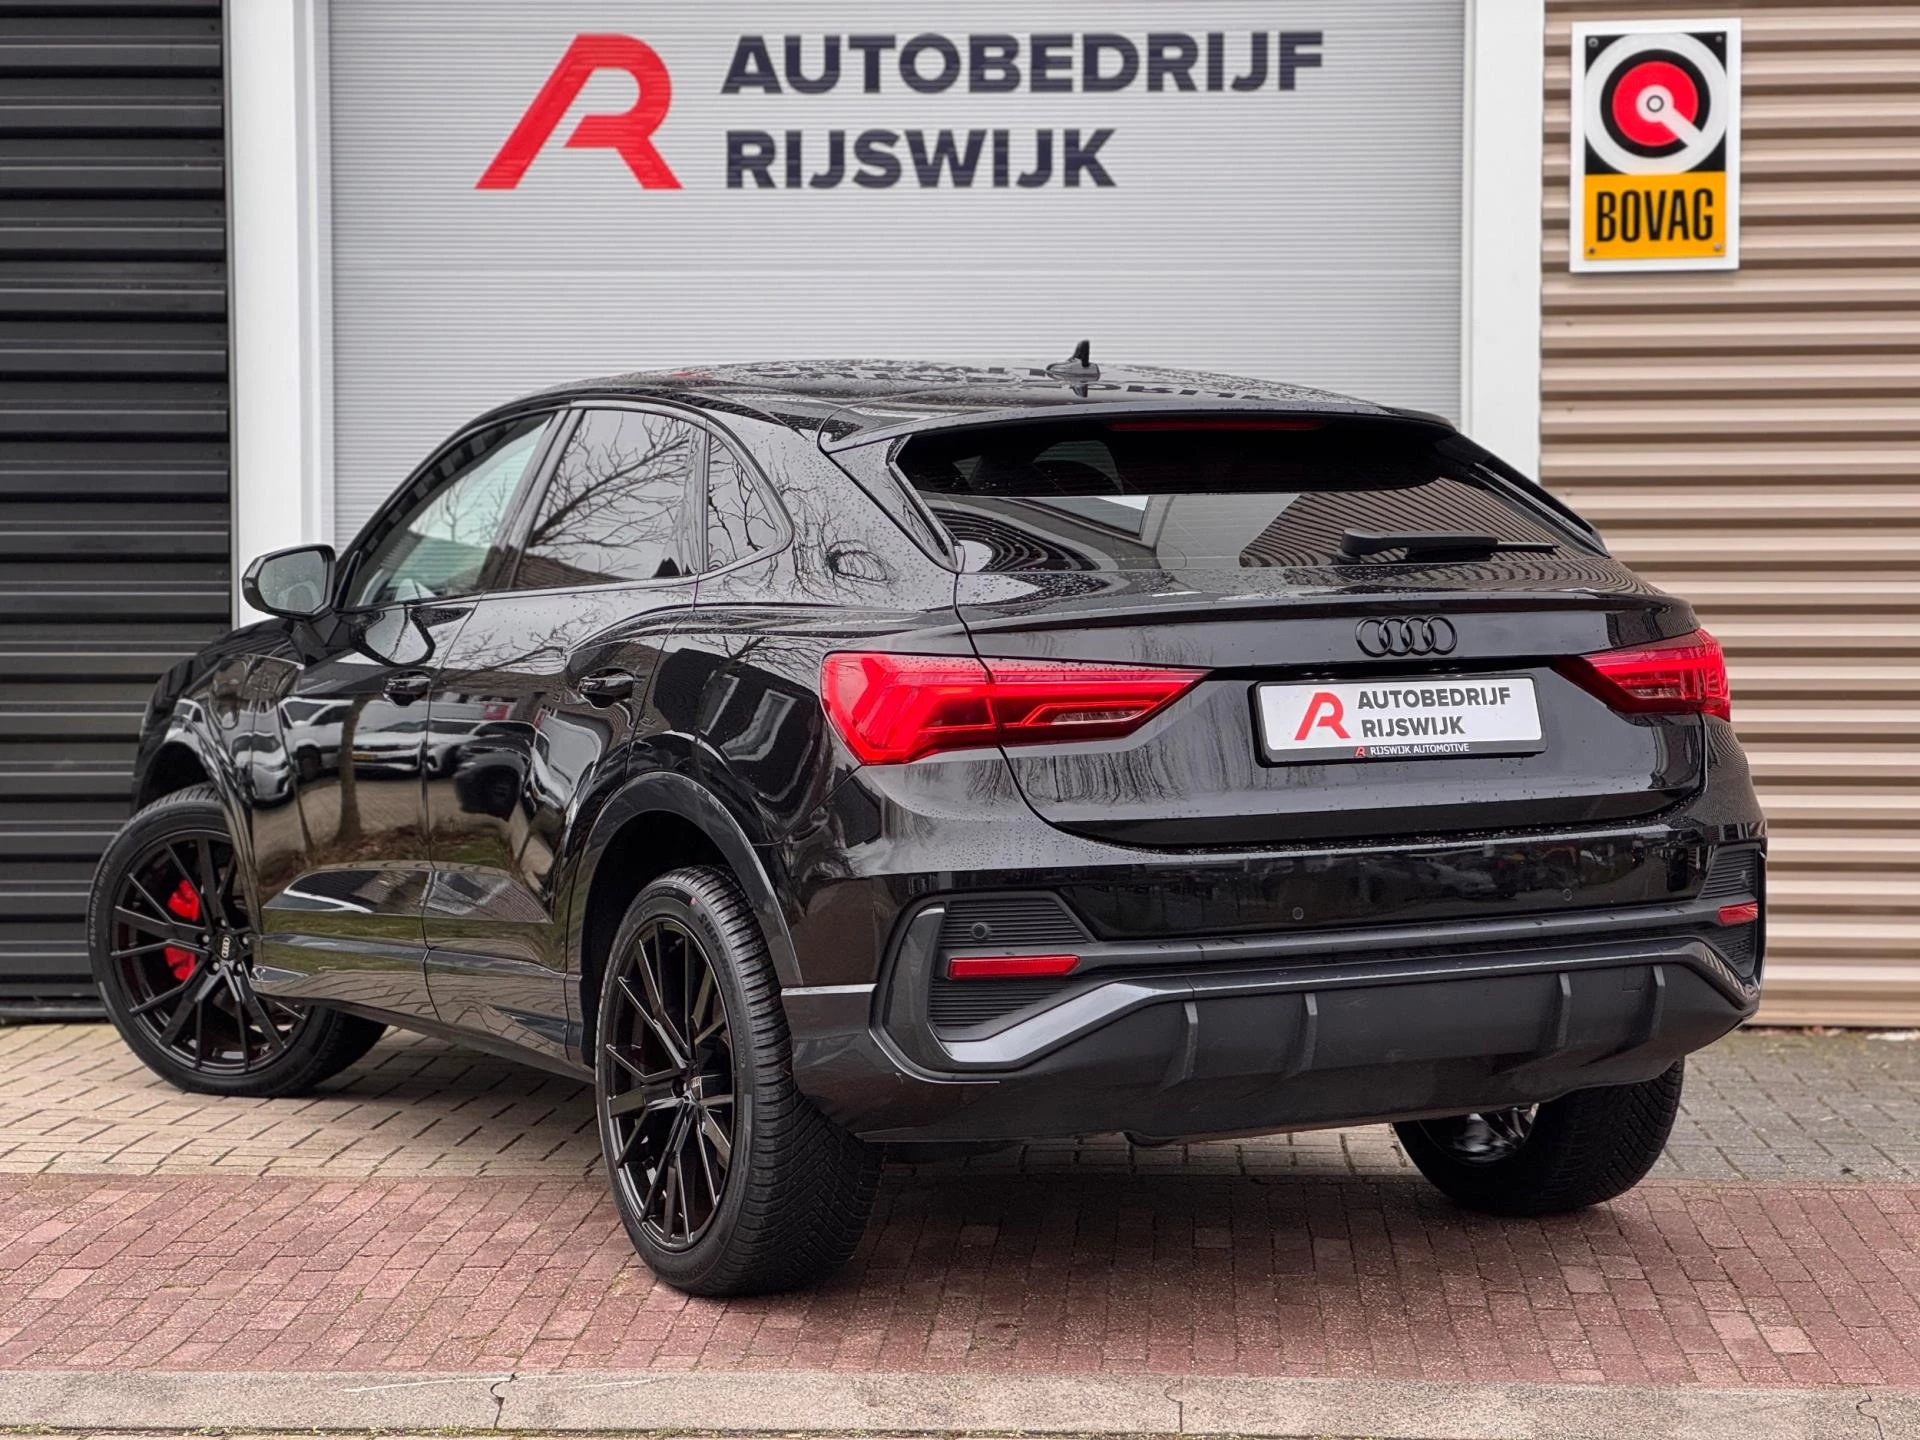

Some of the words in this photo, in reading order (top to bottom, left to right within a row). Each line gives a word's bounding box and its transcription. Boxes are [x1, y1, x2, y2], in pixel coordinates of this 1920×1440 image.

[721, 31, 1323, 94] AUTOBEDRIJF
[726, 128, 1116, 189] RIJSWIJK
[1596, 188, 1714, 243] BOVAG
[1358, 687, 1511, 709] AUTOBEDRIJF
[1361, 716, 1465, 737] RIJSWIJK
[1370, 745, 1412, 756] RIJSWIJK
[1413, 743, 1471, 754] AUTOMOTIVE
